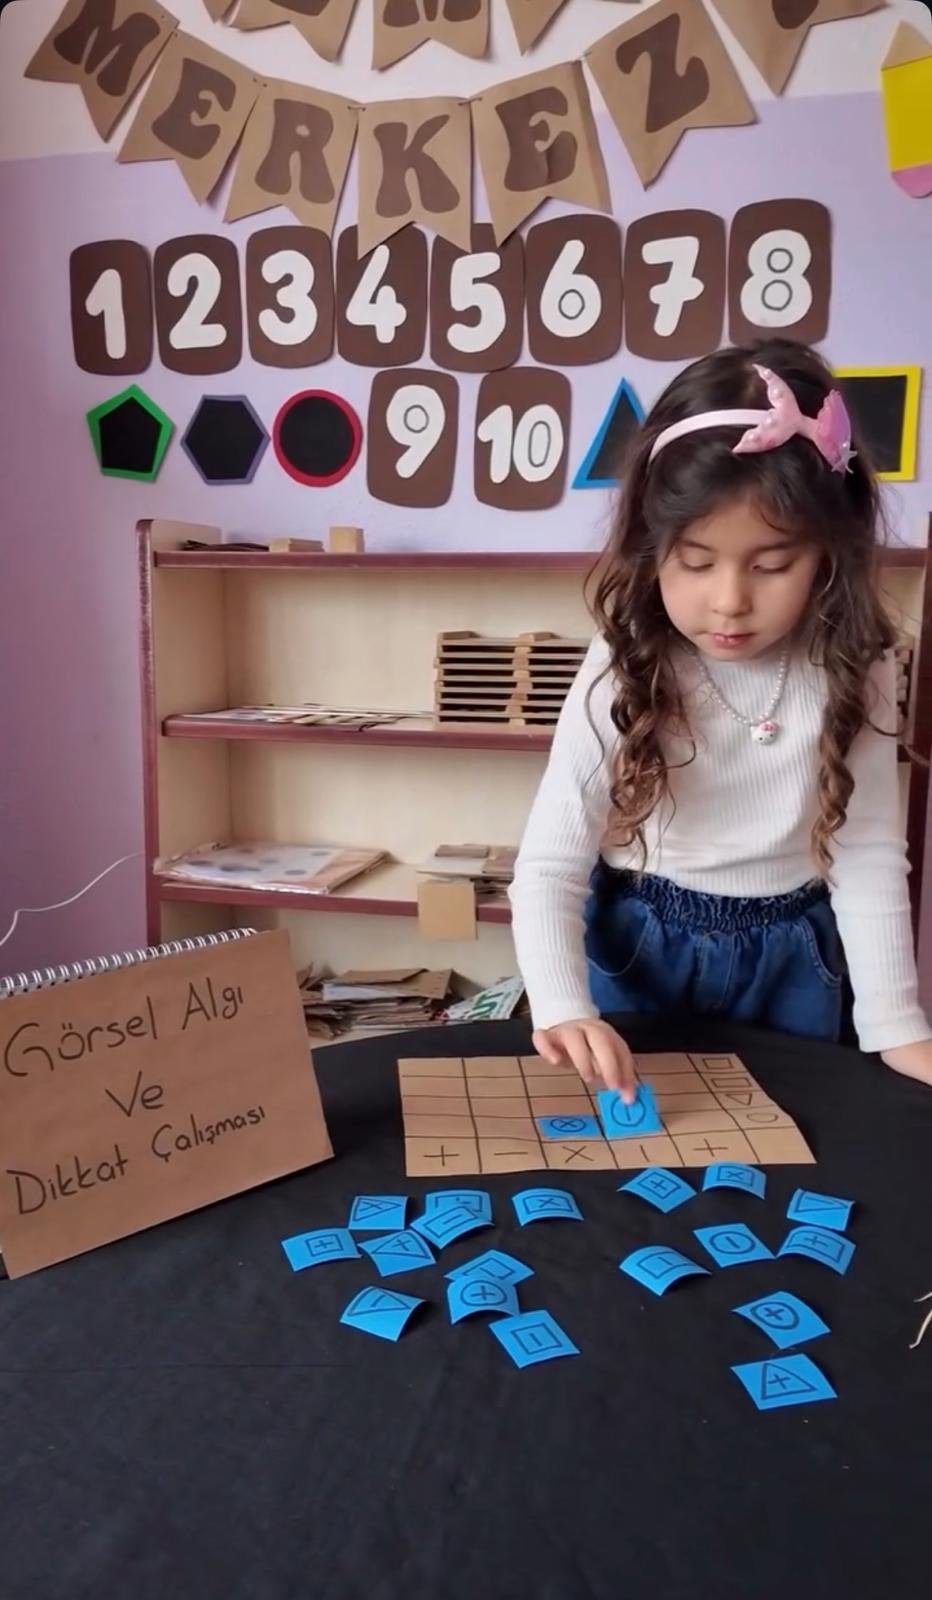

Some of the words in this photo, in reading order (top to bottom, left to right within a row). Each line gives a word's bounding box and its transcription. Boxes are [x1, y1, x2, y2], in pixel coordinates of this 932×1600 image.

[85, 267, 126, 359] 1
[168, 253, 226, 349] 2
[258, 250, 318, 346] 3
[346, 245, 407, 343] 4
[447, 252, 506, 353] 5
[540, 240, 601, 339] 6
[642, 236, 704, 336] 7
[741, 229, 812, 328] 8
[386, 384, 446, 479] 9
[478, 403, 564, 483] 10
[4, 996, 158, 1077] Görsel
[182, 977, 244, 1030] Algı
[105, 1070, 165, 1117] Ve
[6, 1144, 129, 1215] Dikkat
[151, 1106, 266, 1162] Çalışması
